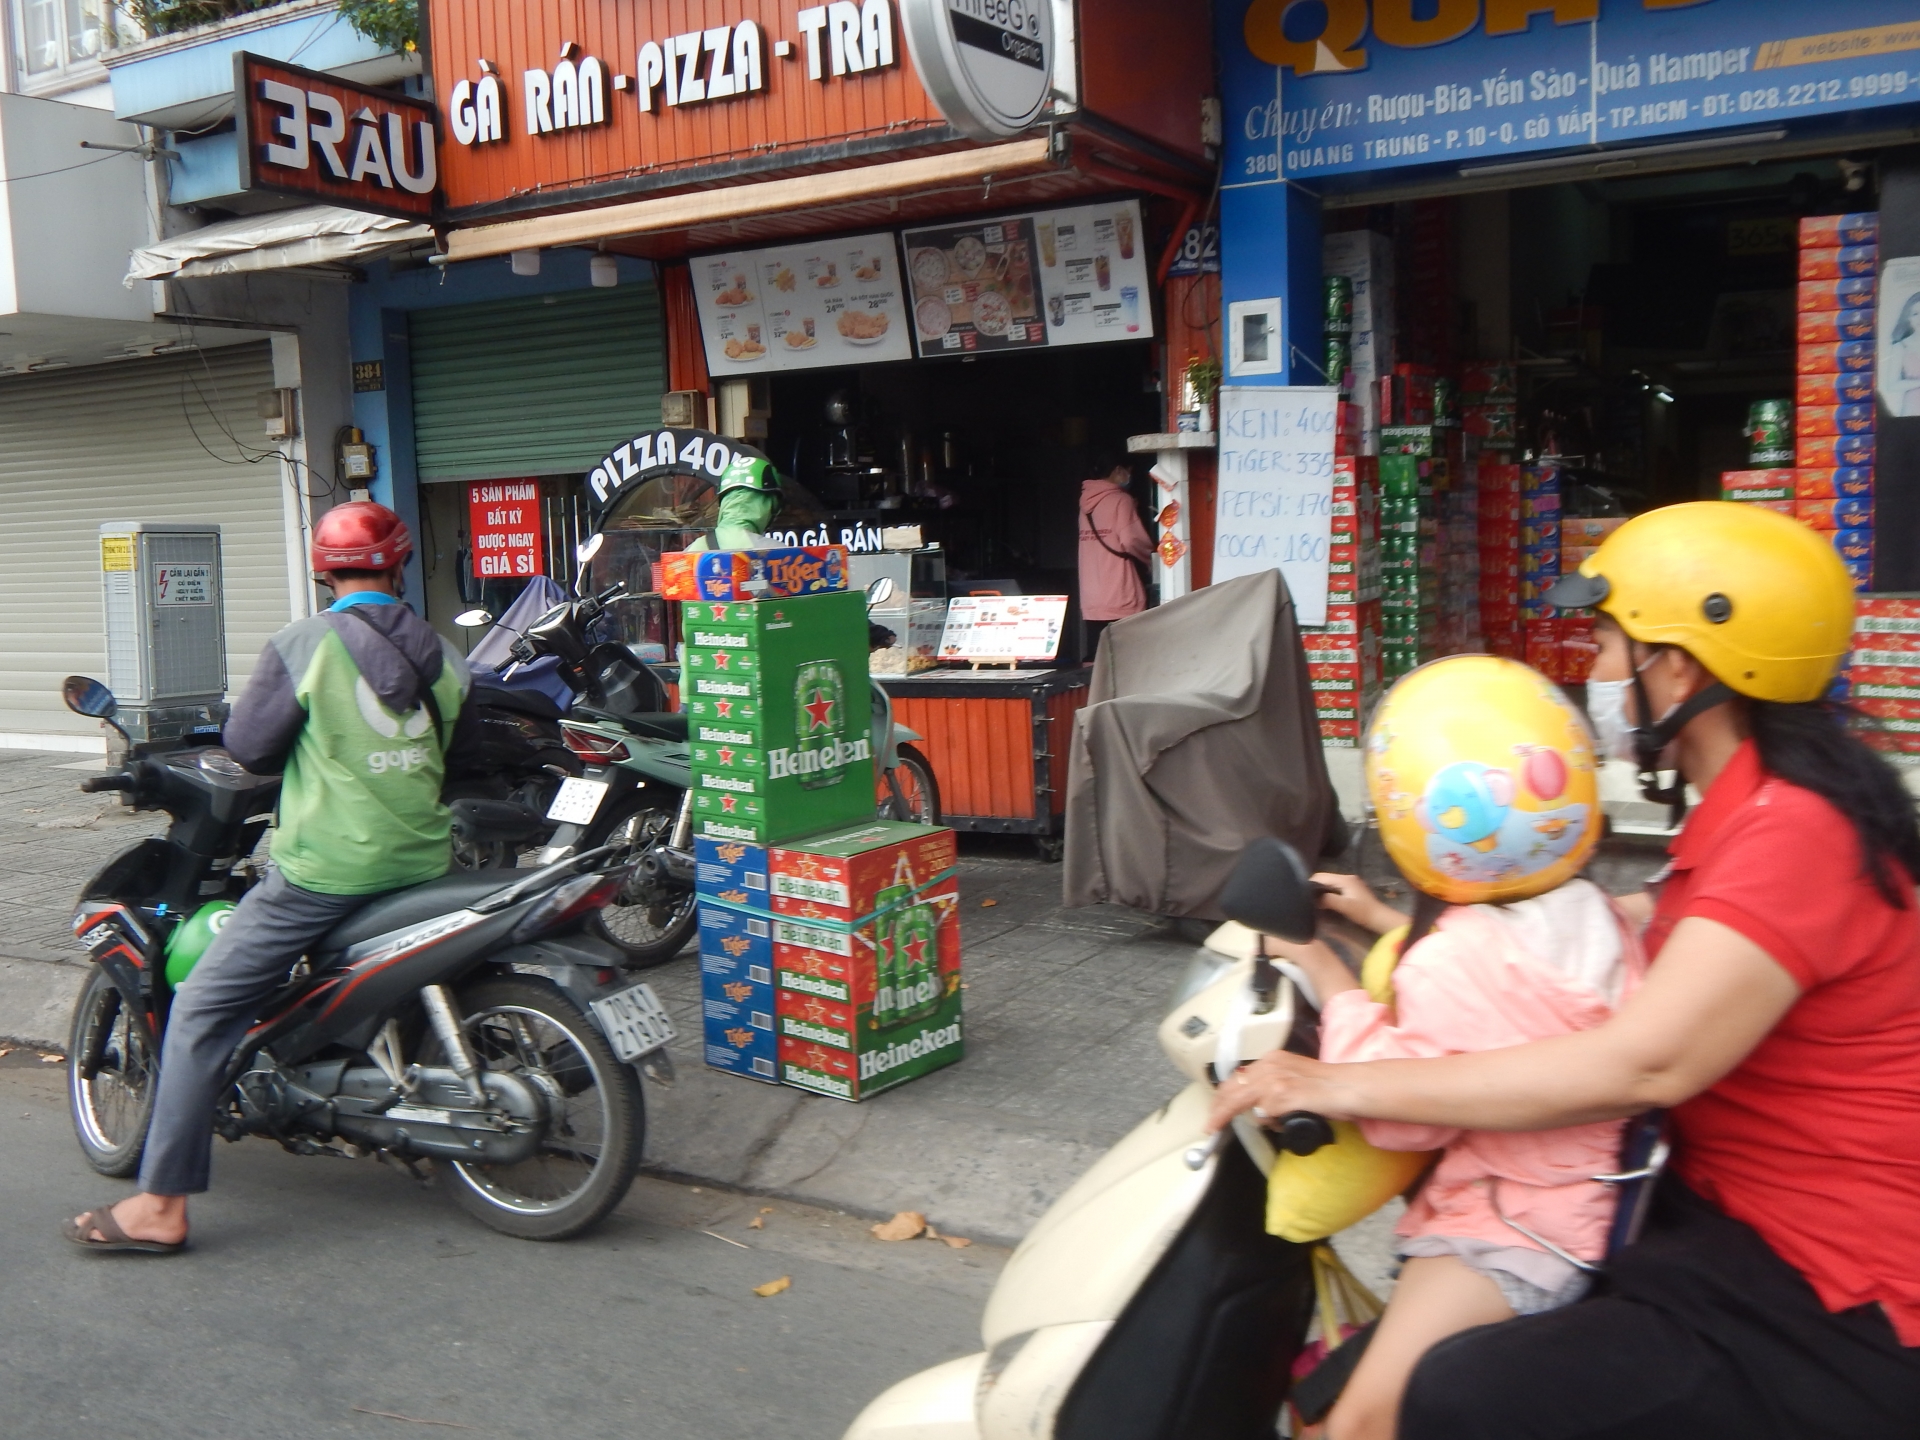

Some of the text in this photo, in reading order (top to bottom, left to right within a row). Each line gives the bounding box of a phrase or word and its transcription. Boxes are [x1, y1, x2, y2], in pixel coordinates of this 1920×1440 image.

[1002, 31, 1042, 62] Organic
[1649, 47, 1751, 86] Hamper
[451, 59, 503, 146] GÀ
[524, 42, 605, 136] RÁN
[638, 19, 763, 112] PIZZA
[1245, 156, 1278, 175] 380
[1287, 143, 1354, 171] QUANG
[1364, 132, 1430, 160] TRUNG
[1446, 132, 1462, 151] P.
[1466, 127, 1487, 147] 10
[1610, 99, 1688, 129] TP.HCM
[1703, 93, 1736, 118] ĐT:
[1167, 226, 1219, 262] 82
[355, 362, 382, 380] 384
[1296, 407, 1336, 433] 400
[590, 431, 676, 503] PIZZA
[1296, 451, 1334, 478] 335
[472, 488, 479, 503] 5
[481, 481, 503, 503] SẢN
[1296, 492, 1332, 517] 170
[487, 506, 507, 526] BẤT
[478, 532, 535, 551] ĐƯỢC NGAY
[802, 522, 830, 547] GÀ
[841, 521, 883, 552] RÁN
[1282, 533, 1327, 563] 180
[480, 548, 535, 575] GIÁ SỈ
[767, 554, 824, 594] Tiger
[705, 580, 731, 597] Tiger
[694, 631, 749, 648] Heineken
[1306, 651, 1351, 661] eineken
[697, 679, 751, 696] Heineken
[1311, 680, 1354, 690] eineken
[699, 726, 753, 745] Heineken
[767, 736, 872, 780] Heineken
[701, 773, 755, 793] Heineken
[703, 820, 757, 841] Heineken
[777, 877, 841, 902] Heineken
[779, 924, 843, 950] Heineken
[781, 971, 848, 1001] Heineken
[783, 1018, 850, 1049] Heineken
[859, 1022, 962, 1082] Heineken
[785, 1064, 852, 1097] Heineken
